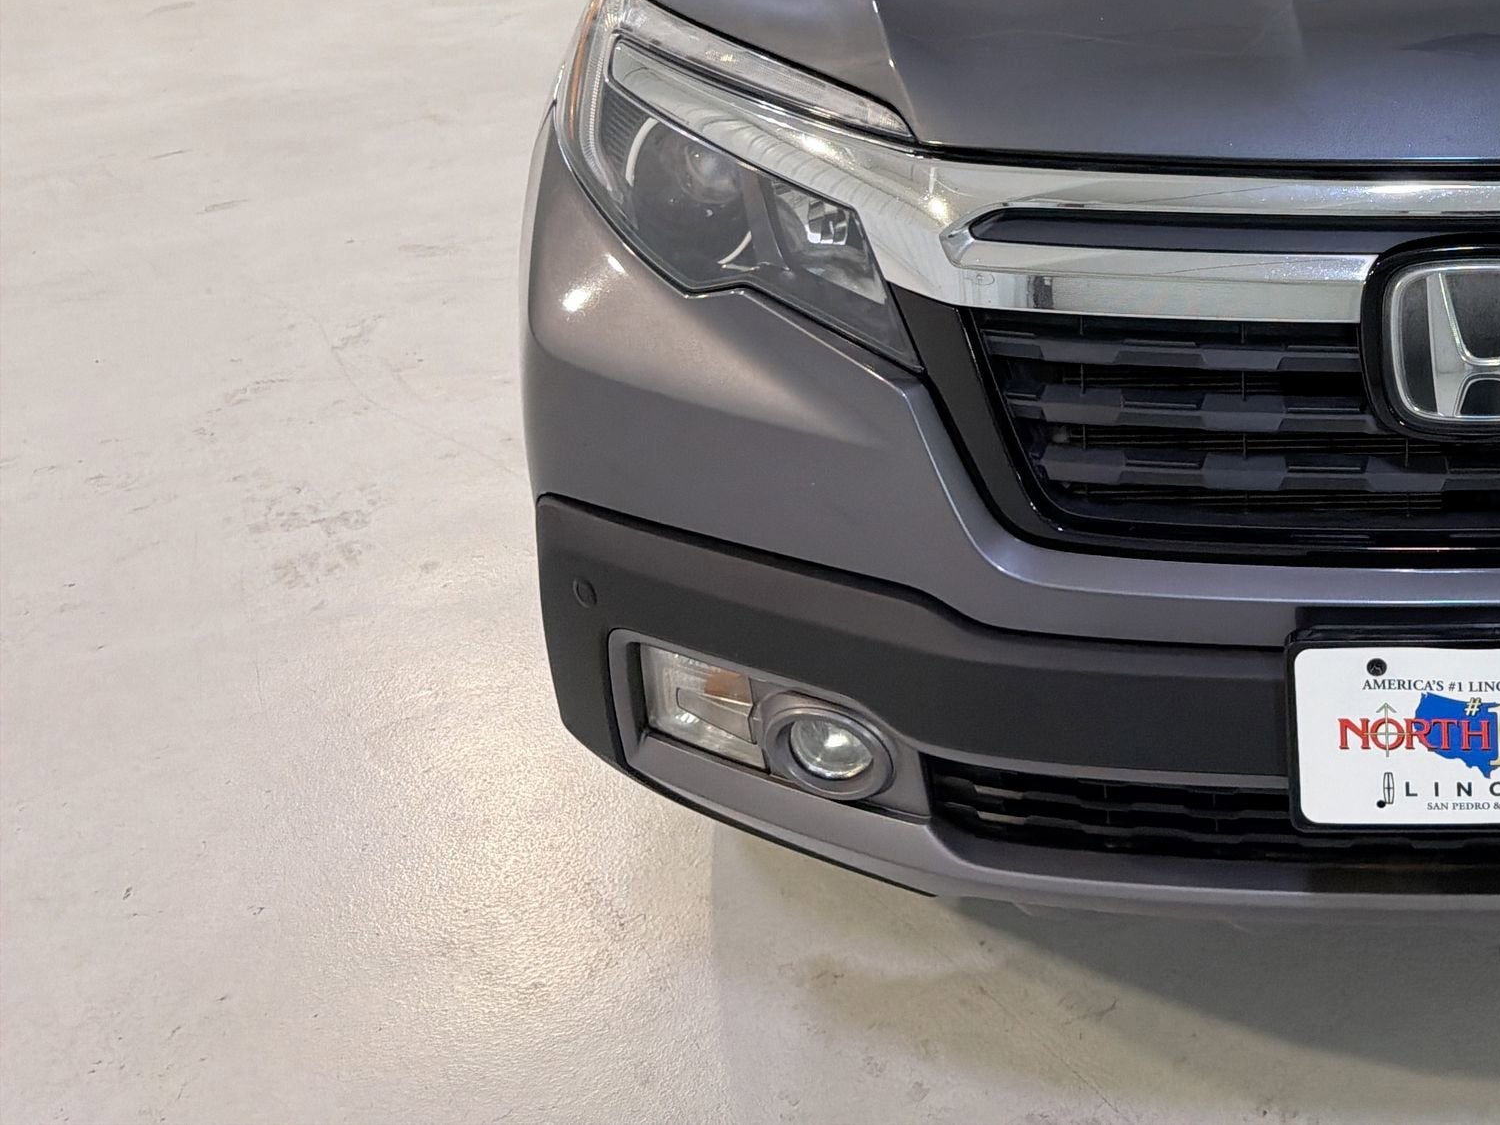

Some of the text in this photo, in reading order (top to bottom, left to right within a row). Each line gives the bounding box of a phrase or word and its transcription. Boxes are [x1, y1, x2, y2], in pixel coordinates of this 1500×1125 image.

[1362, 679, 1444, 692] AMERICA'S
[1448, 681, 1462, 693] #1
[1338, 717, 1491, 752] NORTH
[1427, 801, 1449, 811] SAN
[1450, 801, 1490, 811] PEDRO
